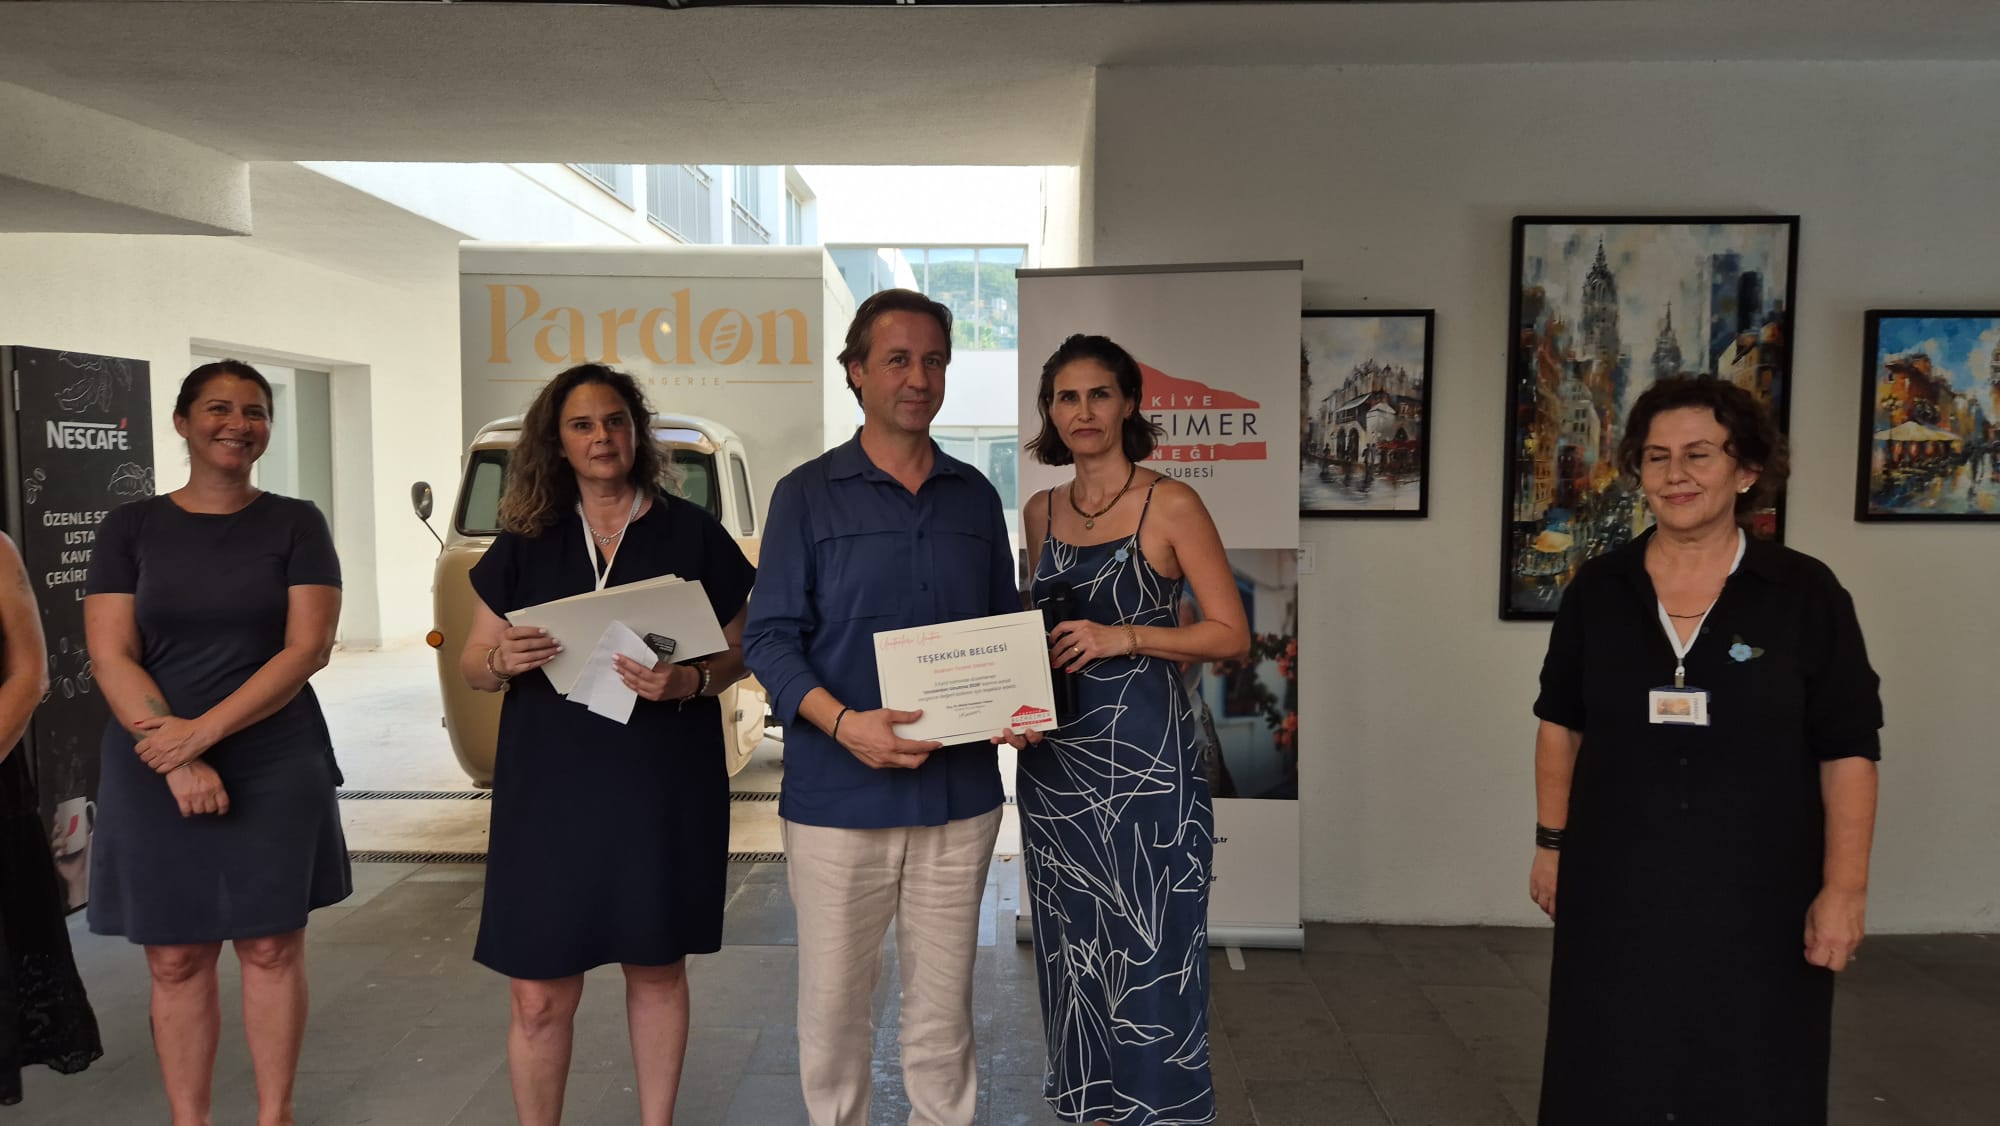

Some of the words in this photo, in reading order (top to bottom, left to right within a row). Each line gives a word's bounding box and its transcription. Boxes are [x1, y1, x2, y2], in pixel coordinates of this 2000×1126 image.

[485, 284, 814, 365] Pardon
[46, 417, 128, 450] NESCAFÉ
[43, 510, 93, 527] ÖZENLE
[917, 648, 967, 664] TEŞEKKÜR
[969, 642, 1008, 657] BELGESİ
